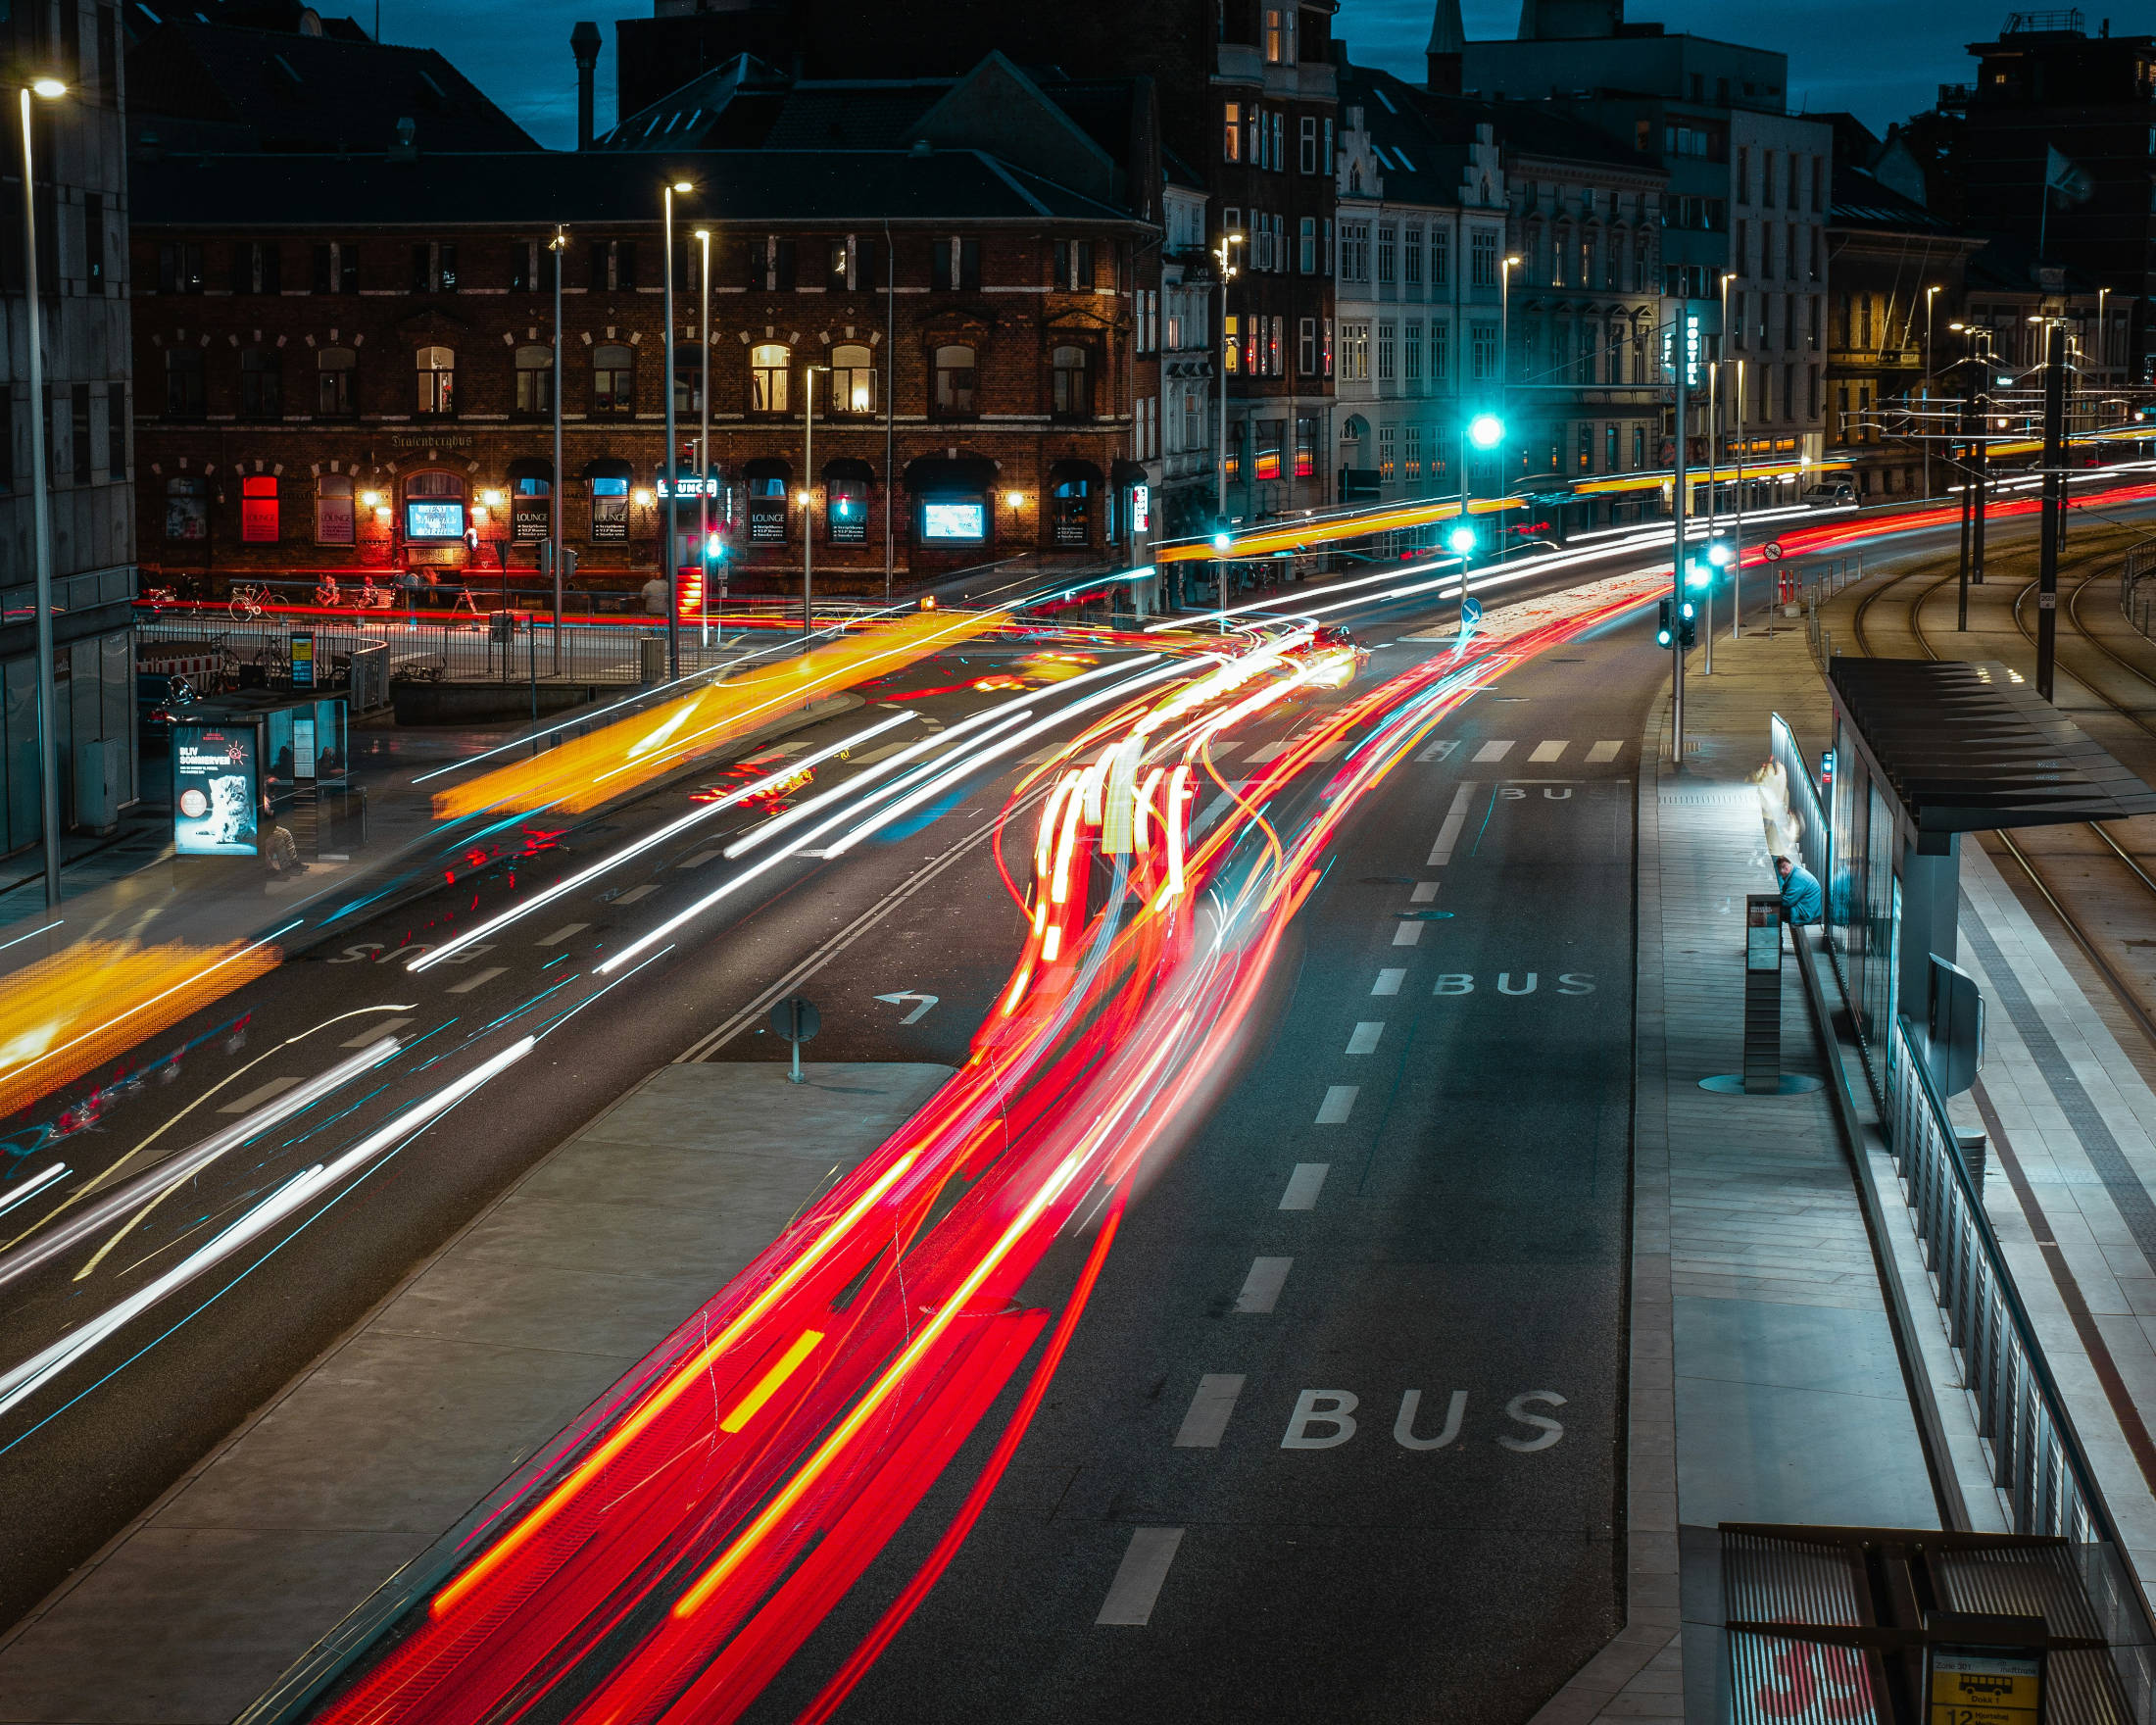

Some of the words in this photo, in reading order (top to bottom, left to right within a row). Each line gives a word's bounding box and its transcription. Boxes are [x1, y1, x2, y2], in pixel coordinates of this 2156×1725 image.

[1687, 317, 1698, 385] HOSTEL
[661, 482, 713, 494] LUNGE
[516, 513, 549, 521] LOUNGE
[595, 513, 627, 521] LOUNGE
[752, 514, 785, 522] LOUNGE
[179, 747, 198, 756] BLIV
[1432, 972, 1596, 996] BUS
[1281, 1389, 1568, 1453] BUS
[1971, 1695, 1992, 1703] Dokk
[1946, 1709, 1973, 1725] 12
